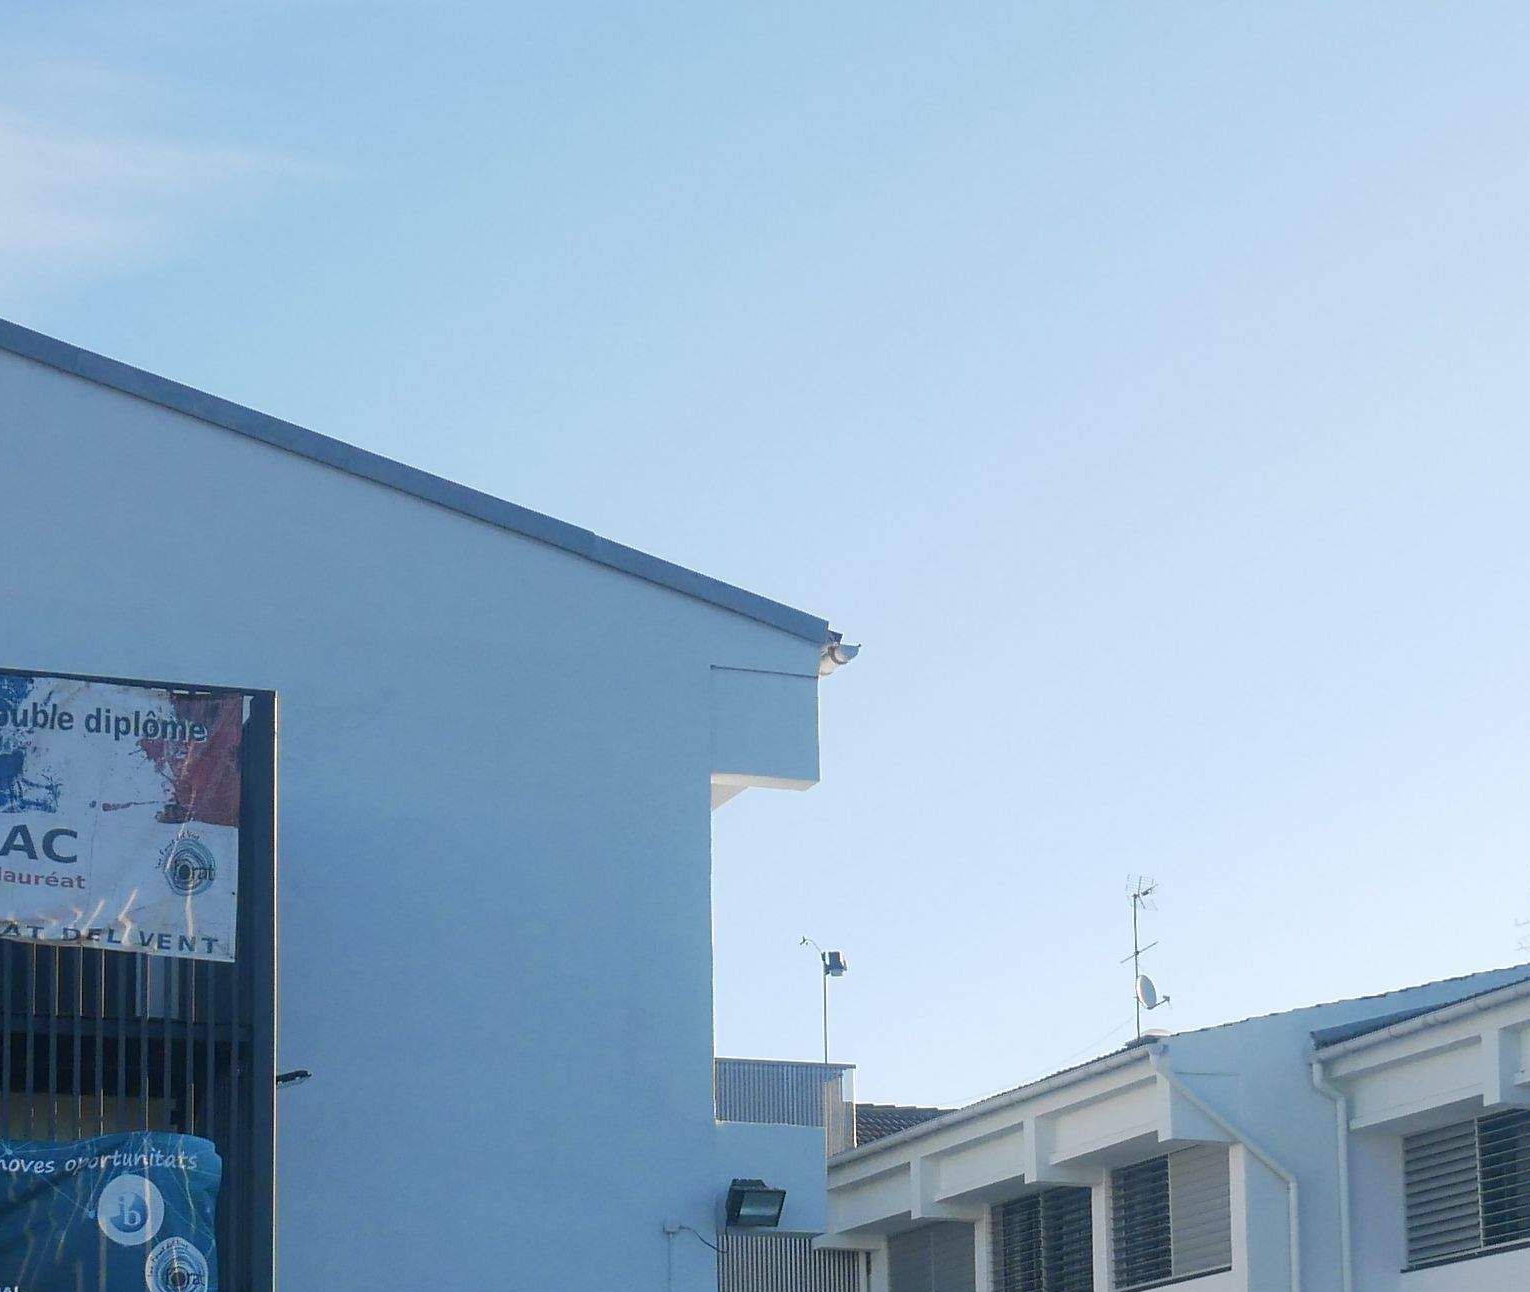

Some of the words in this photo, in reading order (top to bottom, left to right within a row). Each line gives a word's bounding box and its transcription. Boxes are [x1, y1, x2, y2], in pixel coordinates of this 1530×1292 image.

[84, 707, 209, 742] diplôme
[61, 926, 122, 945] DEL
[138, 930, 219, 953] VENT
[65, 1146, 199, 1176] oportunitats
